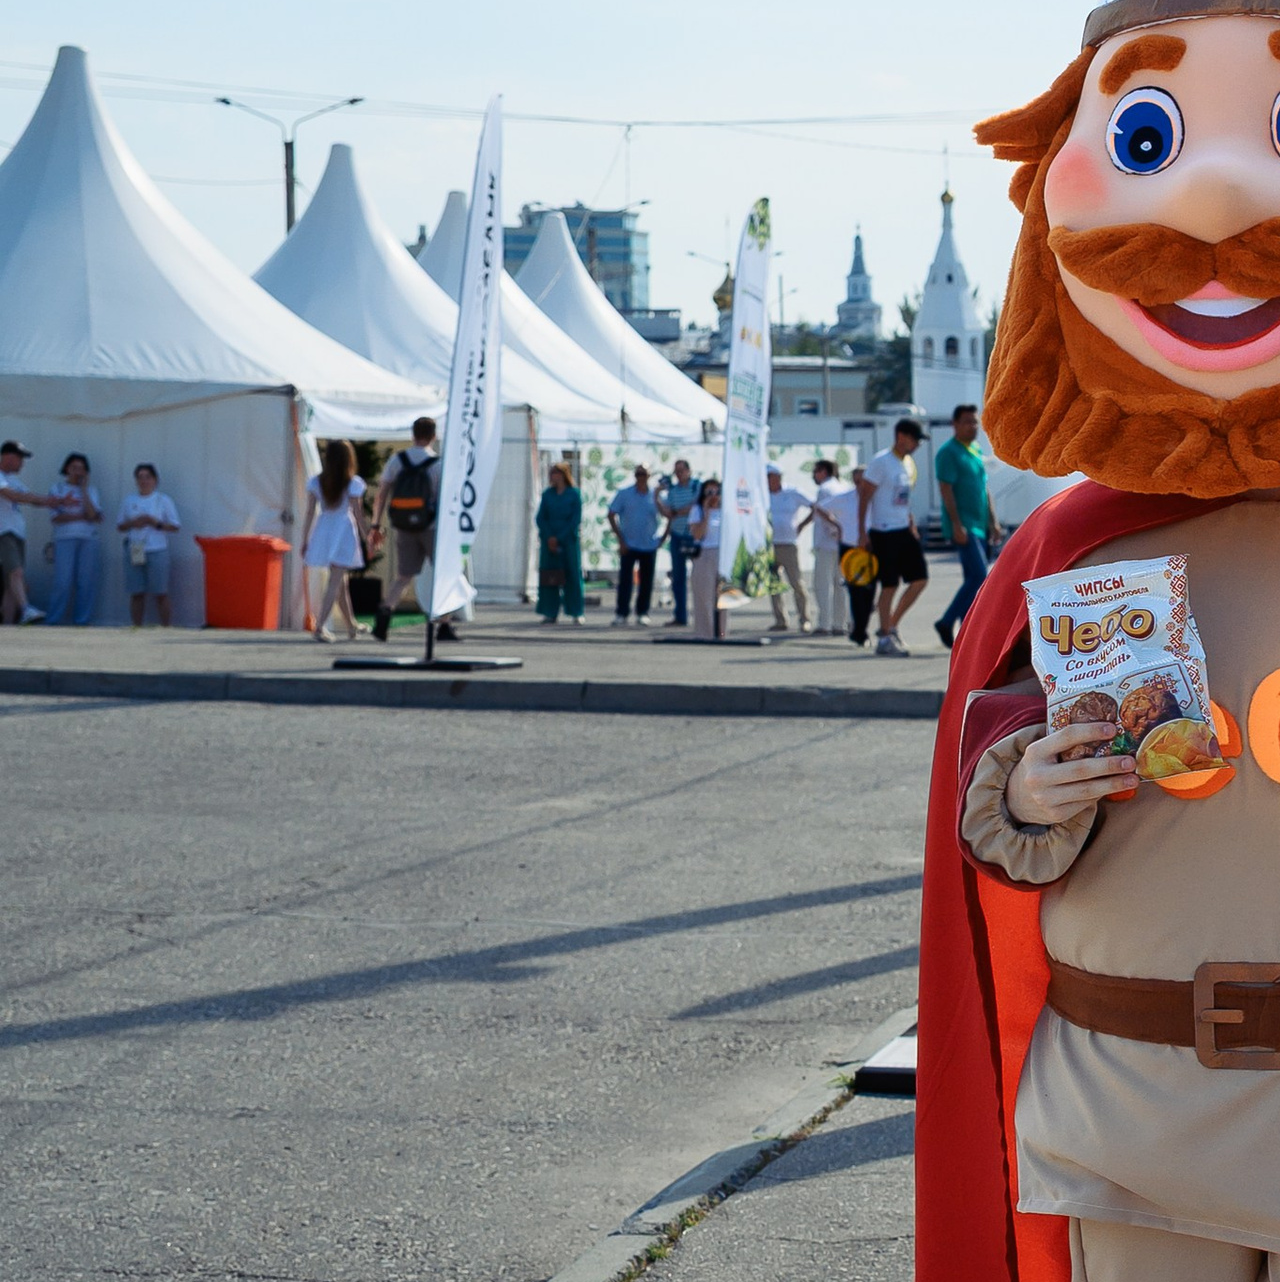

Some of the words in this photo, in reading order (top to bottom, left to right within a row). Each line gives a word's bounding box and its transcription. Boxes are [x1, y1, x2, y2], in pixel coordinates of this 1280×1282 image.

[1062, 595, 1113, 608] НАТУРАЛЬНОГО
[1114, 587, 1149, 600] КАРТОФЕЛЯ
[1075, 575, 1125, 597] ЧИПСЫ
[1039, 604, 1156, 656] Чебо
[1065, 659, 1084, 671] Со
[1087, 637, 1126, 664] вкусом
